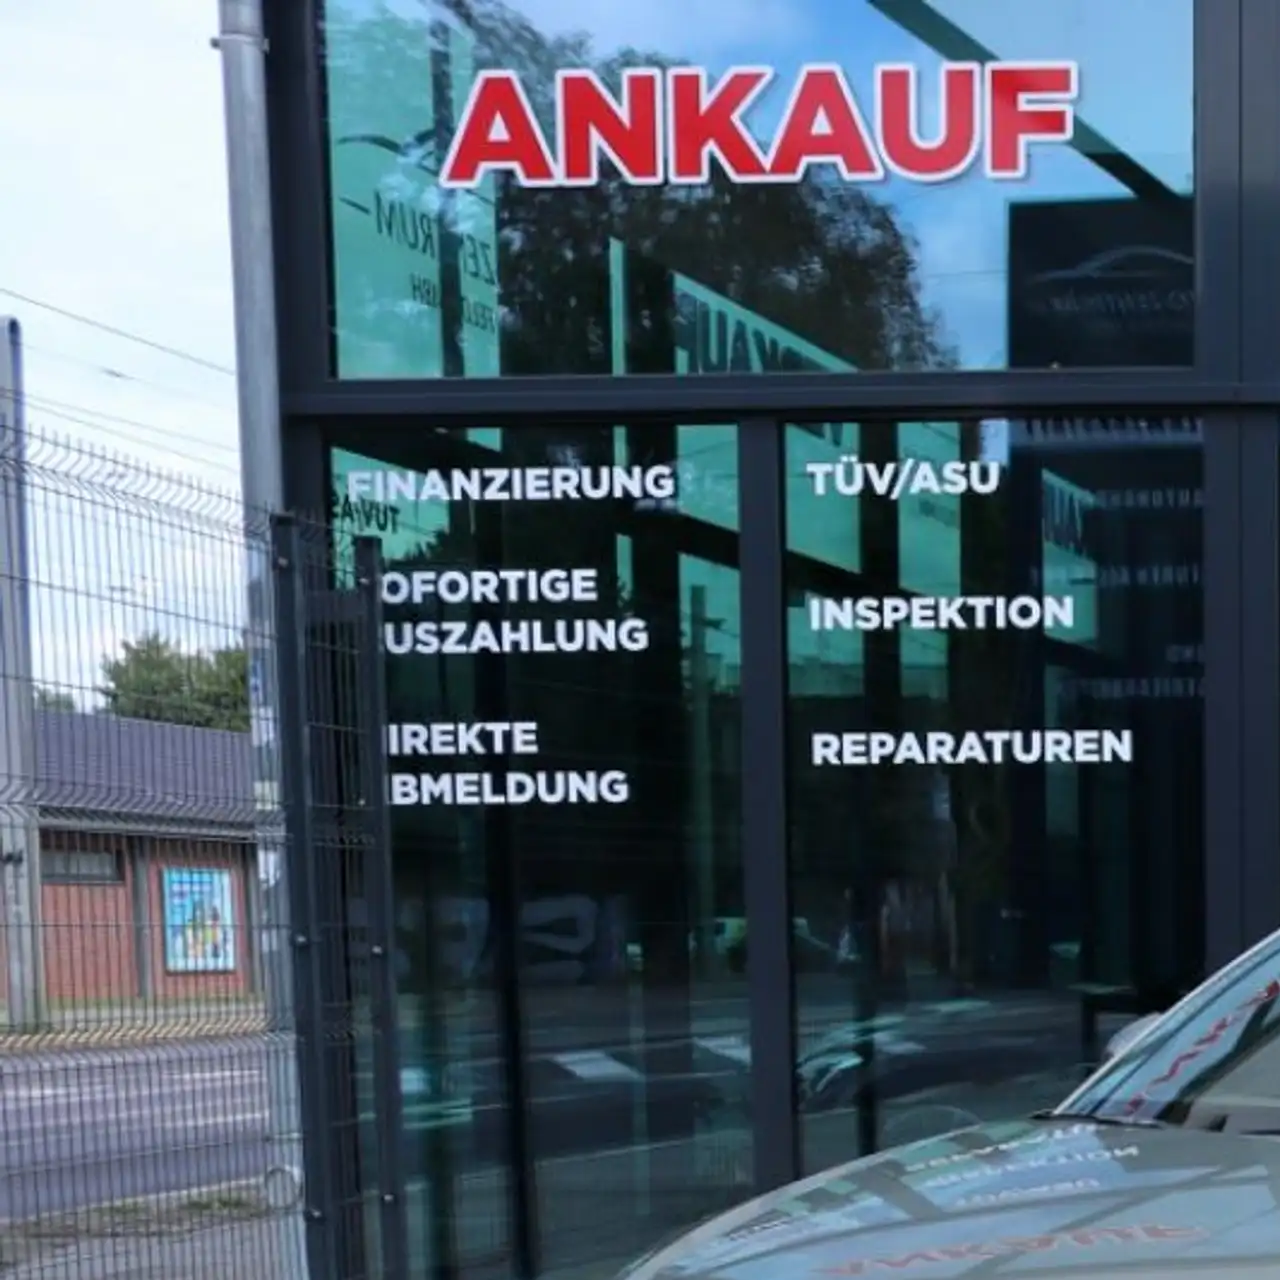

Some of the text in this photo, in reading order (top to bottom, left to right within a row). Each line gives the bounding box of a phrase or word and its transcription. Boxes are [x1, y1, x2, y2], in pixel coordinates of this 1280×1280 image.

[442, 61, 1078, 188] ANKAUF
[348, 465, 676, 502] FINANZIERUNG
[806, 455, 1001, 500] TÜV/ASU
[381, 567, 598, 604] OFORTIGE
[809, 595, 1075, 632] INSPEKTION
[383, 617, 649, 655] USZAHLUNG
[382, 722, 539, 756] IREKTE
[811, 730, 1133, 766] REPARATUREN
[386, 770, 629, 805] BMELDUNG
